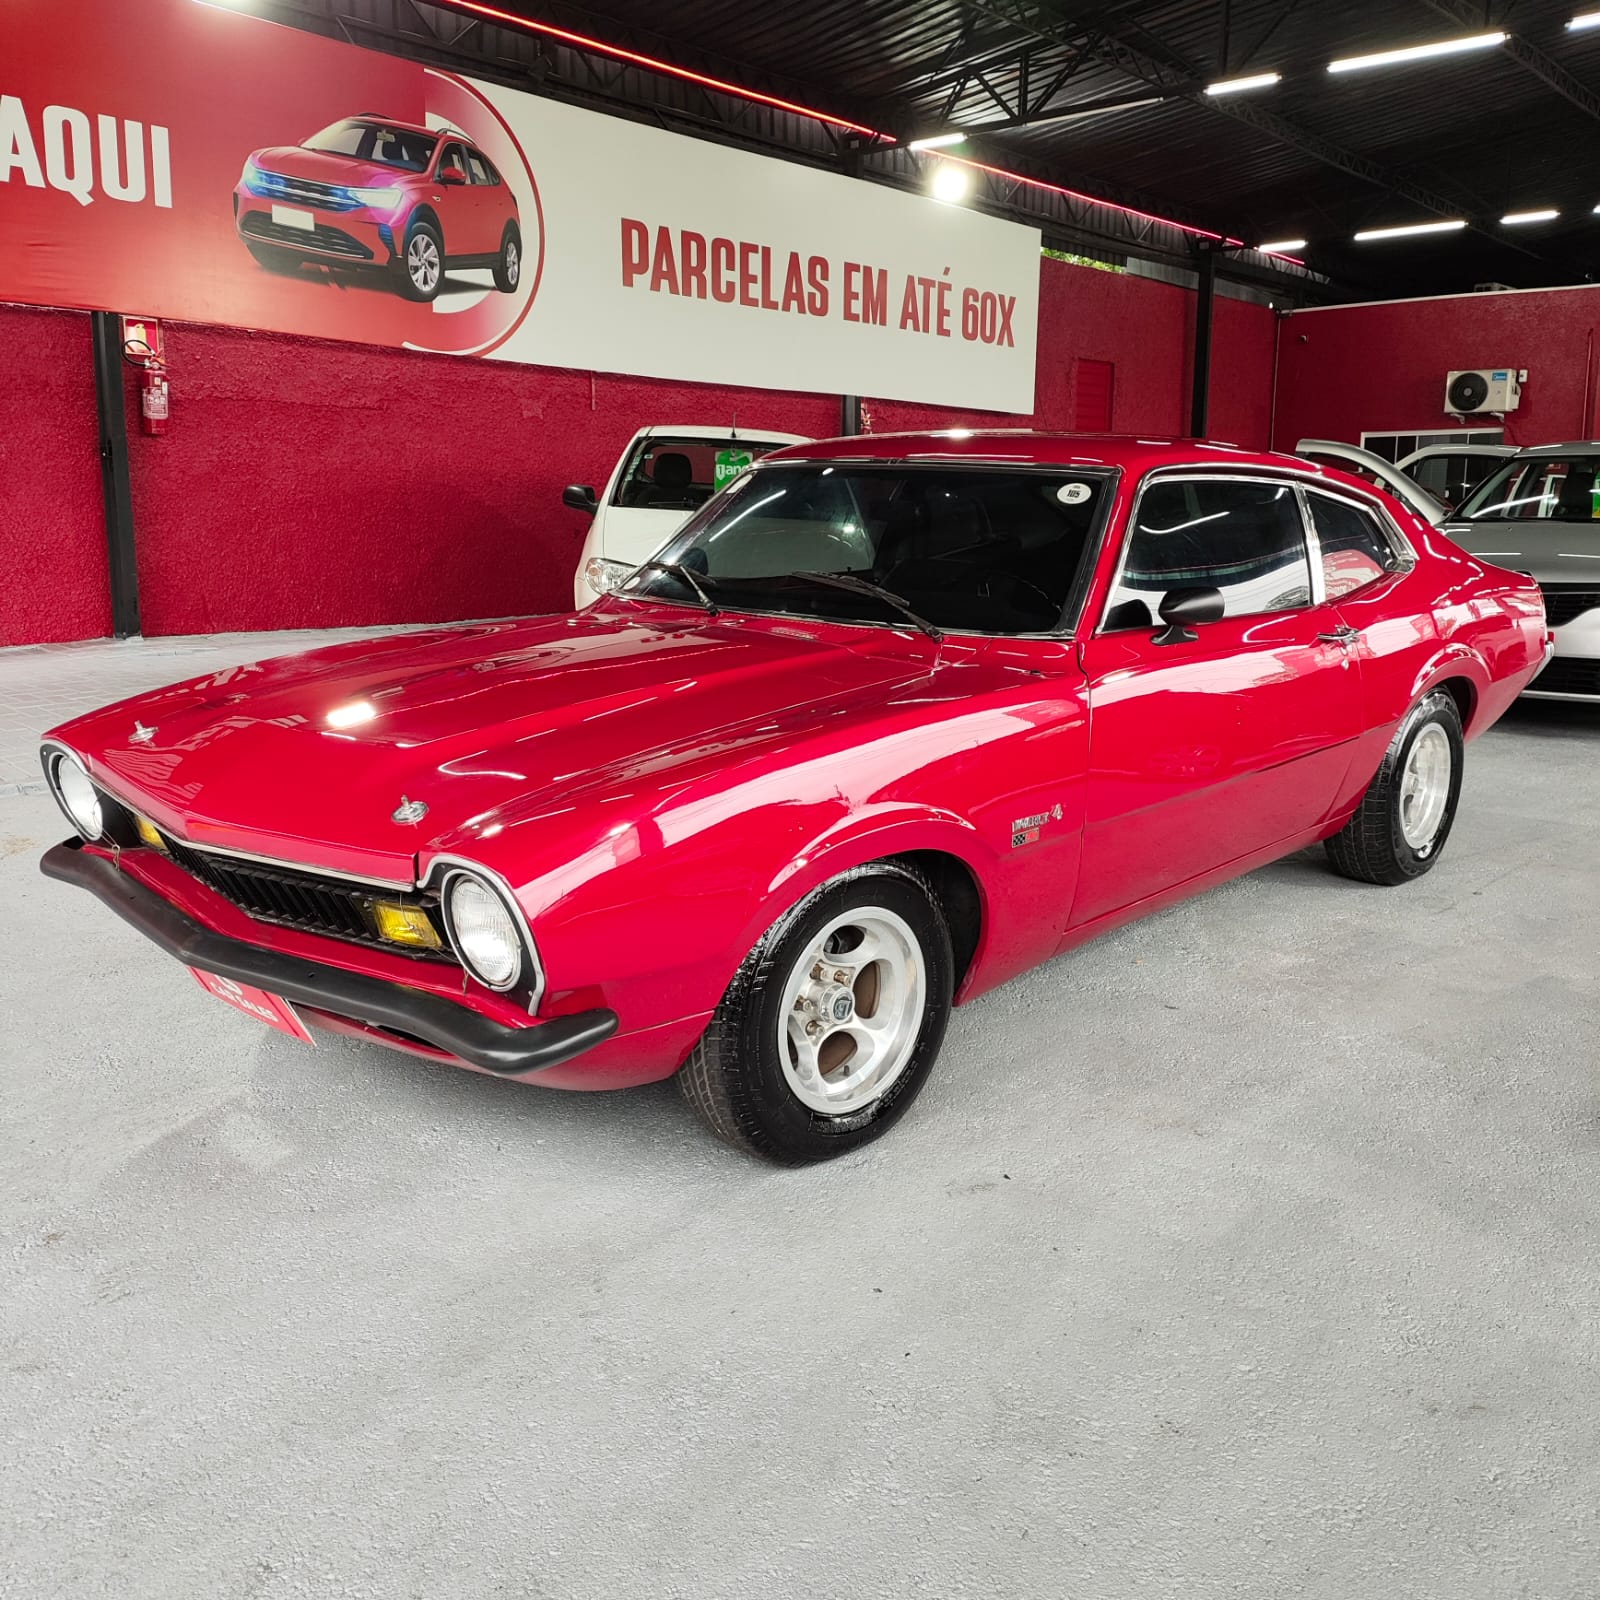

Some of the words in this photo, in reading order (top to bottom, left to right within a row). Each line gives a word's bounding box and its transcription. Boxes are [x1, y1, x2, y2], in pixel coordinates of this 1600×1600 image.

[0, 94, 173, 209] AQUI
[620, 216, 830, 318] PARCELAS
[843, 261, 888, 327] EM
[899, 266, 953, 338] ATÉ
[961, 286, 1017, 349] 60X
